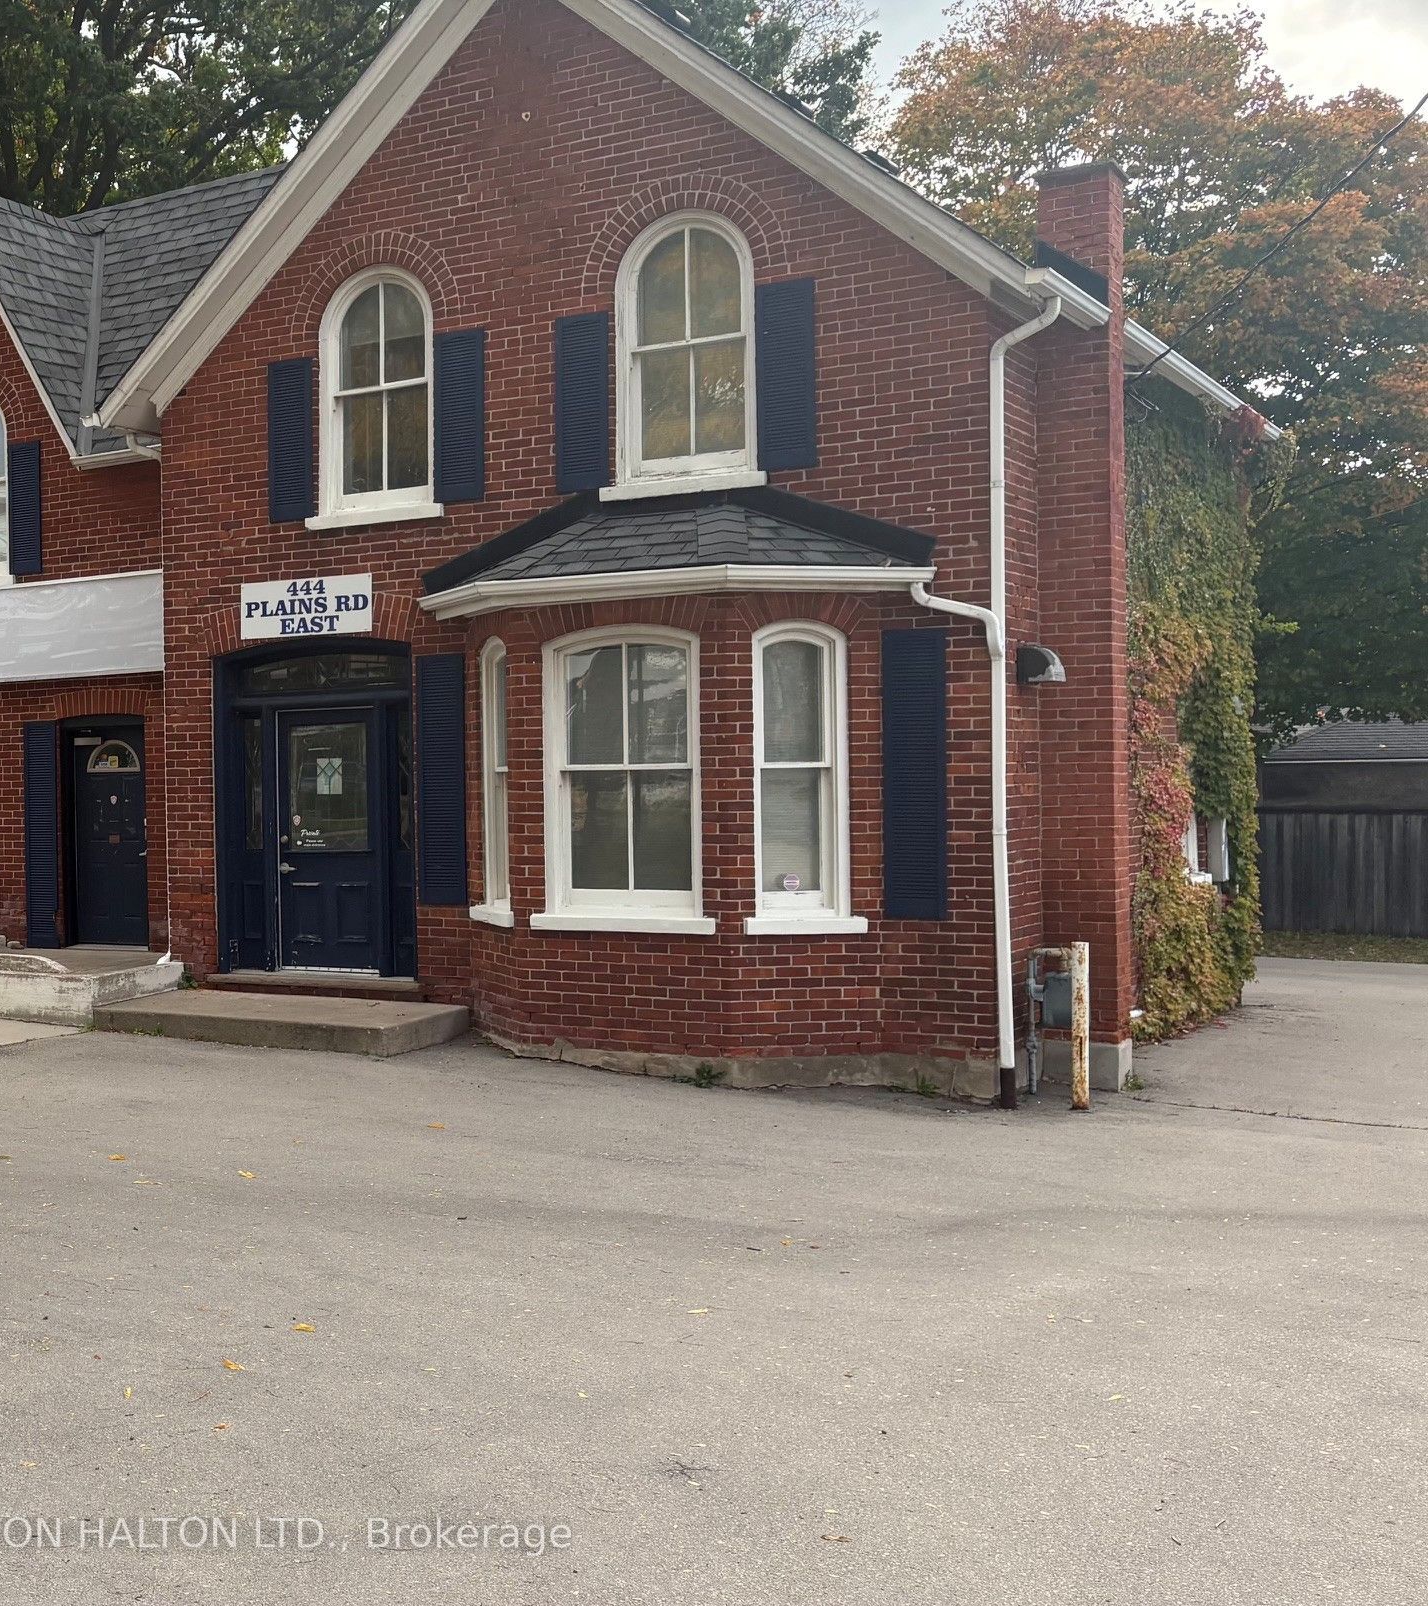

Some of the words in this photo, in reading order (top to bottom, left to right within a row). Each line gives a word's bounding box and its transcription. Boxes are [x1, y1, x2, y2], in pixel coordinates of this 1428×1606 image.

[286, 579, 326, 597] 444
[245, 596, 328, 618] PLAINS
[334, 594, 369, 612] RD
[279, 615, 339, 634] EAST
